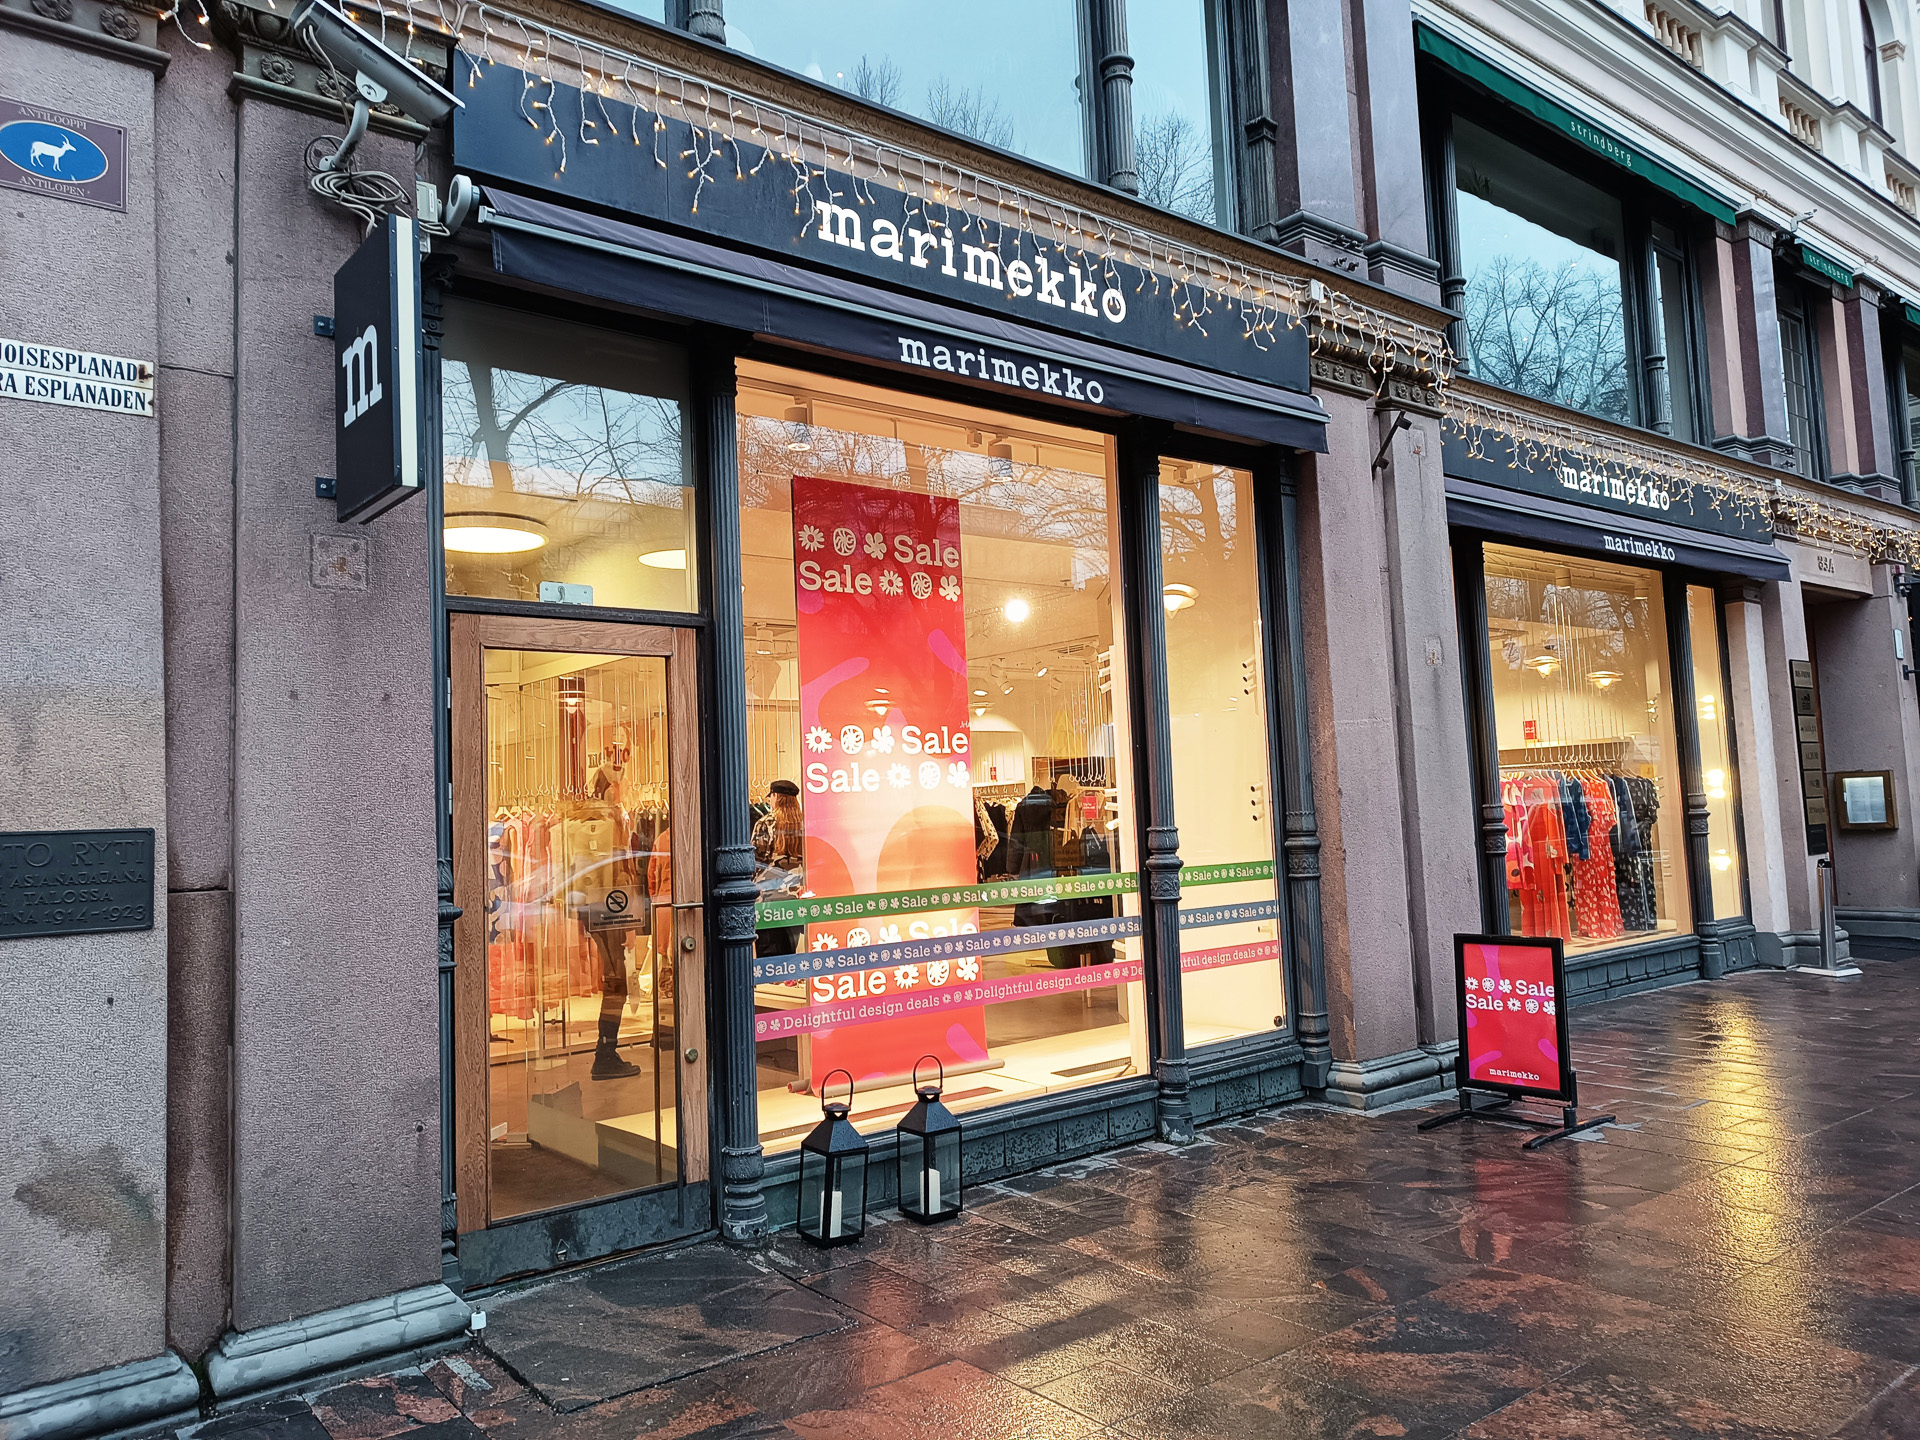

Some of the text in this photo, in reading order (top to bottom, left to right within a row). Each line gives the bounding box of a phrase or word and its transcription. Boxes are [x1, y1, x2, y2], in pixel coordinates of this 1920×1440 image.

[19, 106, 87, 130] ANTILOOPPI
[1570, 121, 1632, 167] strindberg
[20, 176, 85, 197] ANTILOPEN
[815, 199, 1127, 324] marimekko
[1809, 254, 1850, 286] strndberg
[0, 342, 145, 383] OISESPLANAD
[342, 325, 382, 428] m
[898, 336, 1104, 404] marimekko
[25, 375, 146, 411] ESPLANADEN
[1562, 466, 1670, 511] marimekko
[893, 535, 960, 568] Sale
[1603, 535, 1676, 561] marimekko
[799, 560, 873, 595] Sale
[901, 725, 969, 755] Sale
[806, 762, 880, 794] Sale
[72, 839, 145, 866] RYTI
[1192, 866, 1254, 881] Sale Sale
[763, 877, 1138, 922] Sale Sale Sale Sal Sale Sale Sa
[1195, 907, 1257, 923] Sale Sale
[765, 921, 1141, 977] Sale Sale Sale Sale Sale Sale Sa
[1202, 952, 1232, 965] design
[1233, 948, 1256, 960] deals
[783, 1007, 856, 1029] Delightful
[859, 1001, 903, 1018] design
[906, 994, 940, 1011] deals
[975, 980, 1034, 1000] Delightful
[1036, 975, 1072, 990] design
[1074, 971, 1102, 984] deals
[812, 970, 887, 1003] Sale
[1465, 993, 1504, 1011] Sale
[1515, 979, 1555, 997] Sale
[1489, 1067, 1540, 1081] marimekko
